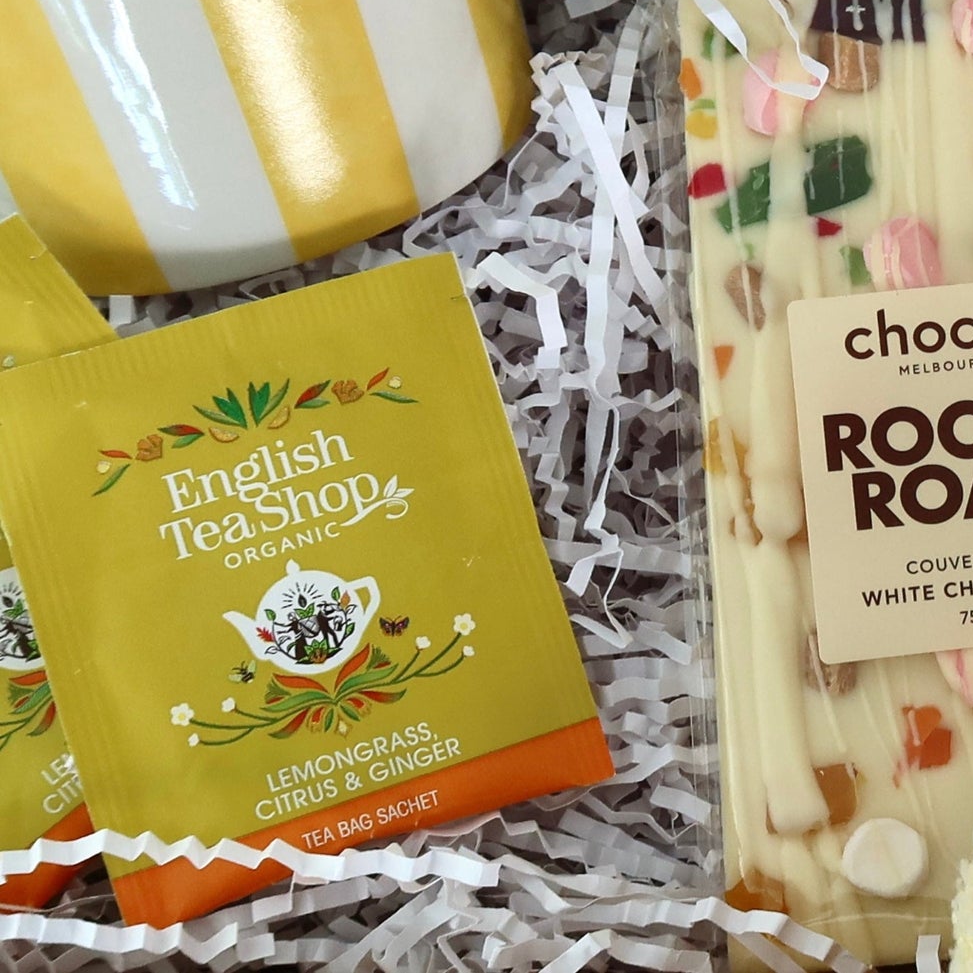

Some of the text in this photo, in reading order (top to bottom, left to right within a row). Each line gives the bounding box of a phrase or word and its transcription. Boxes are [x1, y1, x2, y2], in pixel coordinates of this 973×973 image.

[161, 429, 354, 514] English
[223, 522, 341, 569] ORGANIC
[862, 584, 935, 608] WHITE
[254, 738, 461, 821] CITRUS & GINGER
[265, 722, 439, 794] LEMONGRASS,
[43, 774, 82, 814] CIT
[301, 790, 441, 850] TEA BAG SACHET
